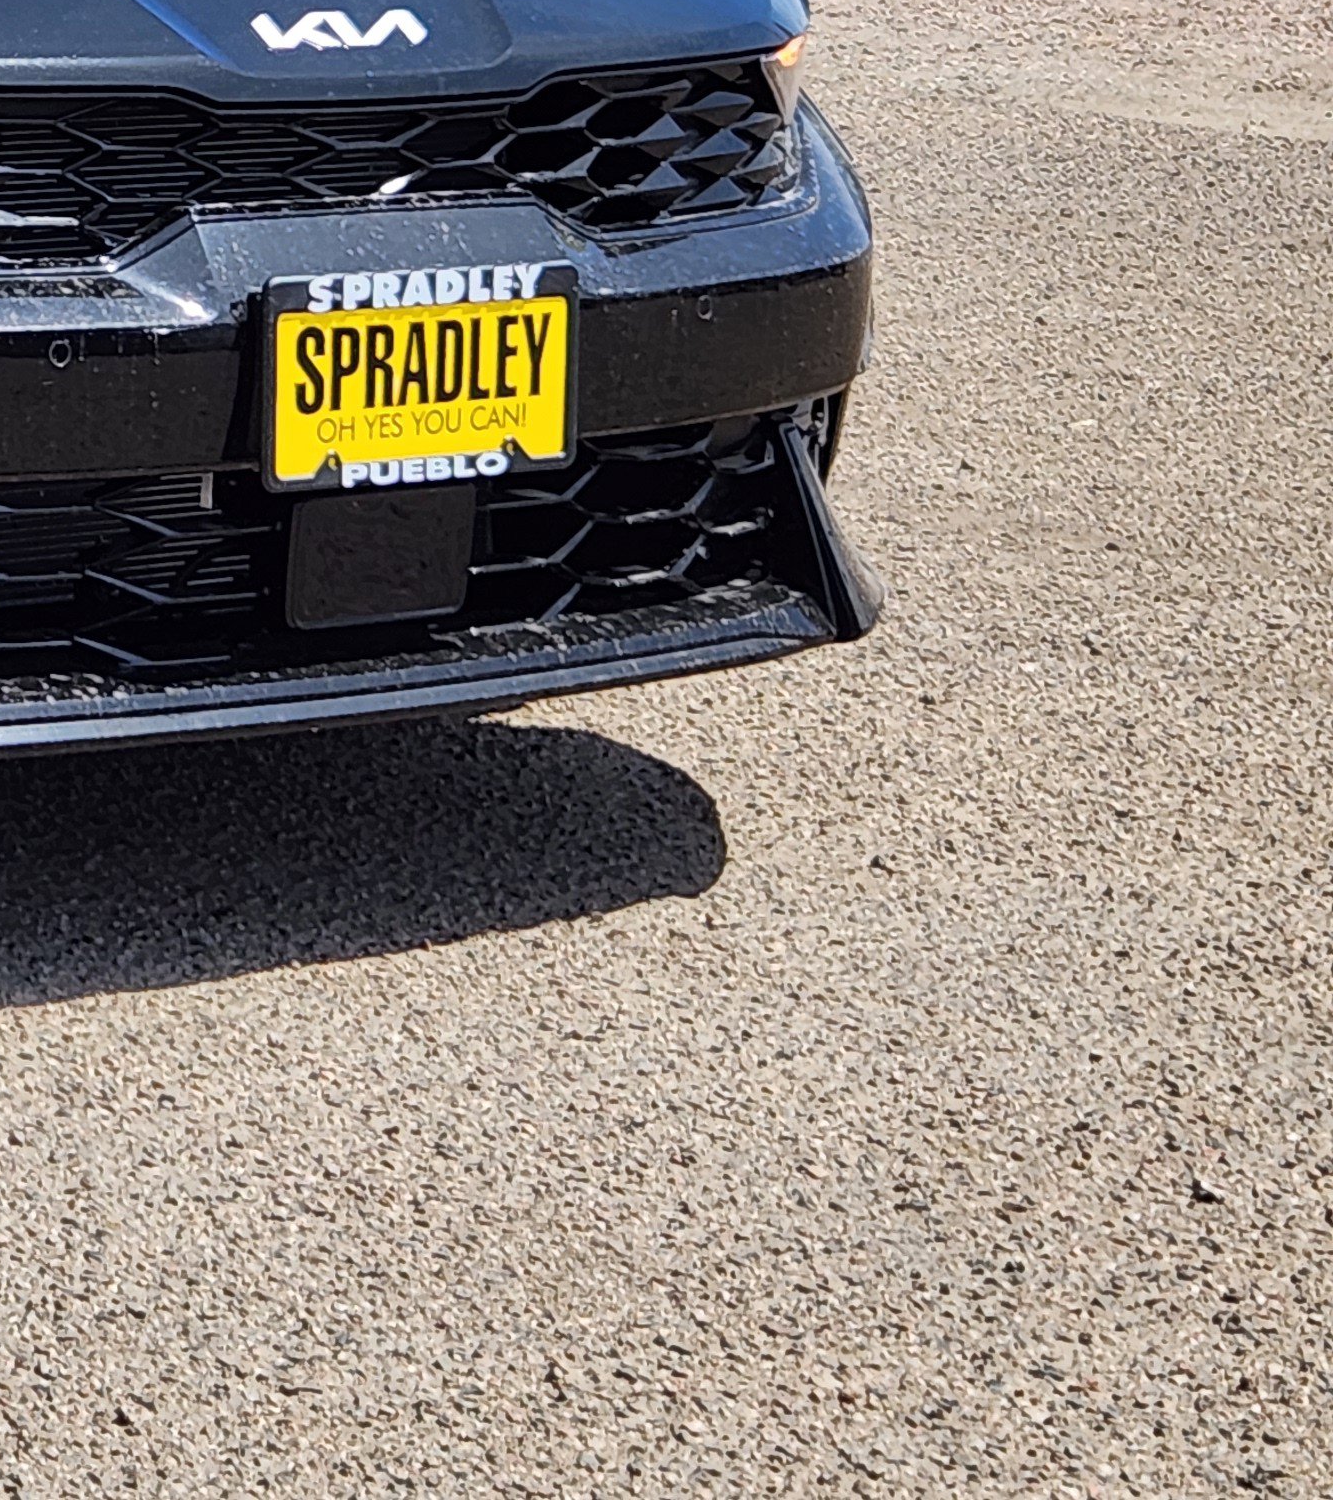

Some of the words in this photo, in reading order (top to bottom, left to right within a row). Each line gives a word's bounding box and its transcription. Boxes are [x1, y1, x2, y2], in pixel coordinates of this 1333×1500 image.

[249, 8, 429, 52] KIA
[308, 265, 543, 312] SPRADLEY
[295, 313, 551, 414] SPRADLEY
[317, 417, 355, 444] OH
[365, 413, 403, 439] YES
[412, 408, 462, 436] YOU
[470, 403, 527, 431] CAN!
[341, 451, 508, 488] PUEBLO
